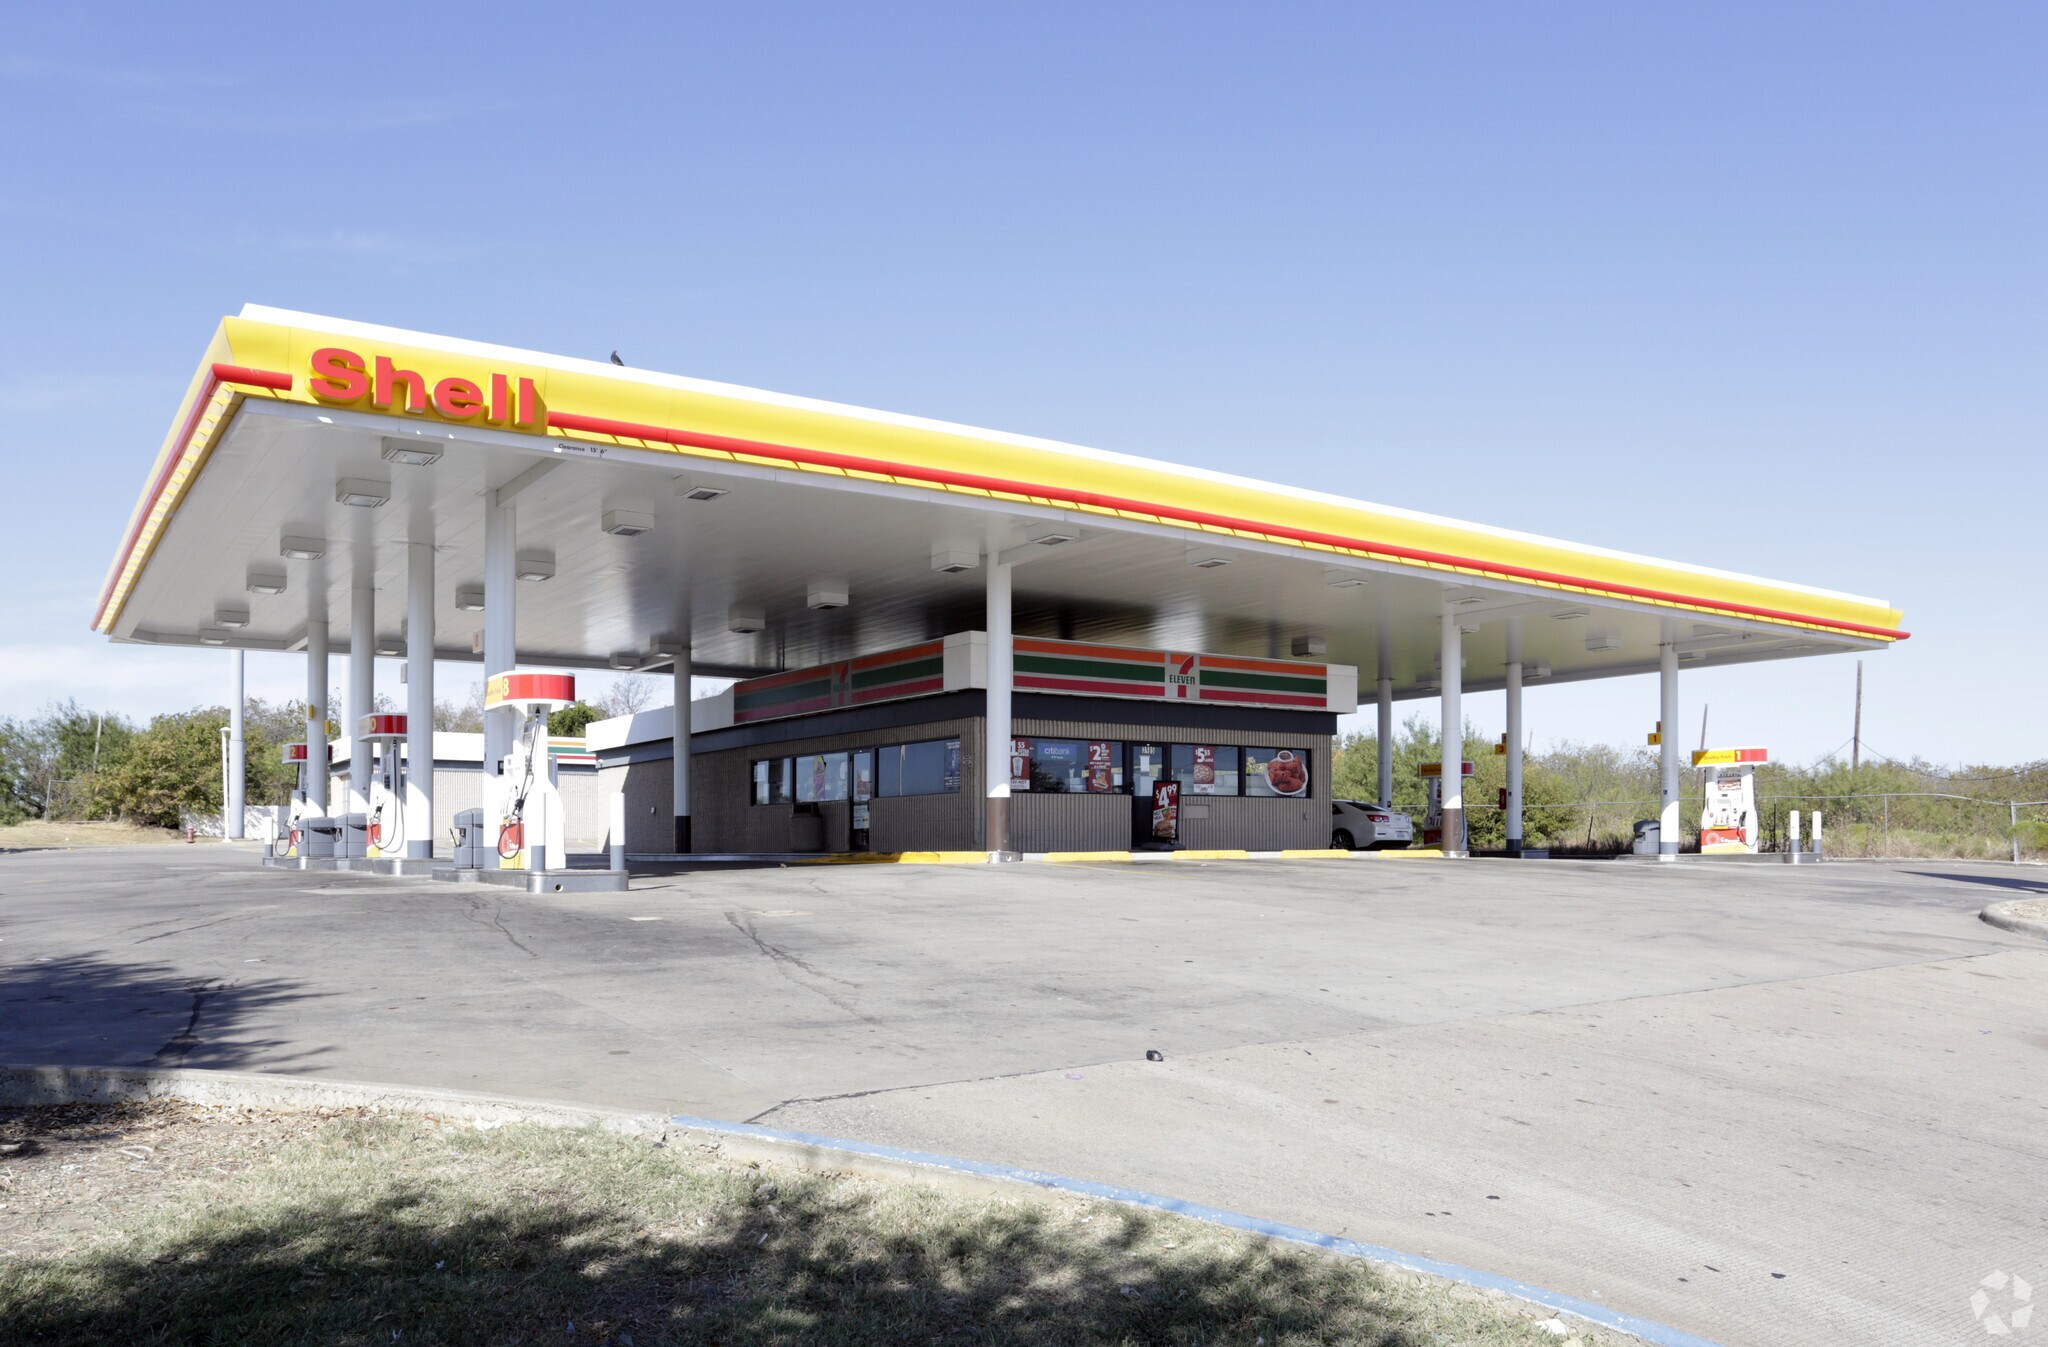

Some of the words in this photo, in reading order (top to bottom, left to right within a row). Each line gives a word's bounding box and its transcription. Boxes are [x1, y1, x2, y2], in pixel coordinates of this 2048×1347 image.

[307, 346, 535, 426] Shell
[558, 443, 585, 452] Clearance
[1177, 655, 1194, 698] 7
[503, 677, 510, 697] 8
[1653, 735, 1657, 743] 1
[1044, 746, 1071, 755] citibank
[1499, 745, 1505, 753] 3
[1735, 750, 1741, 761] 1
